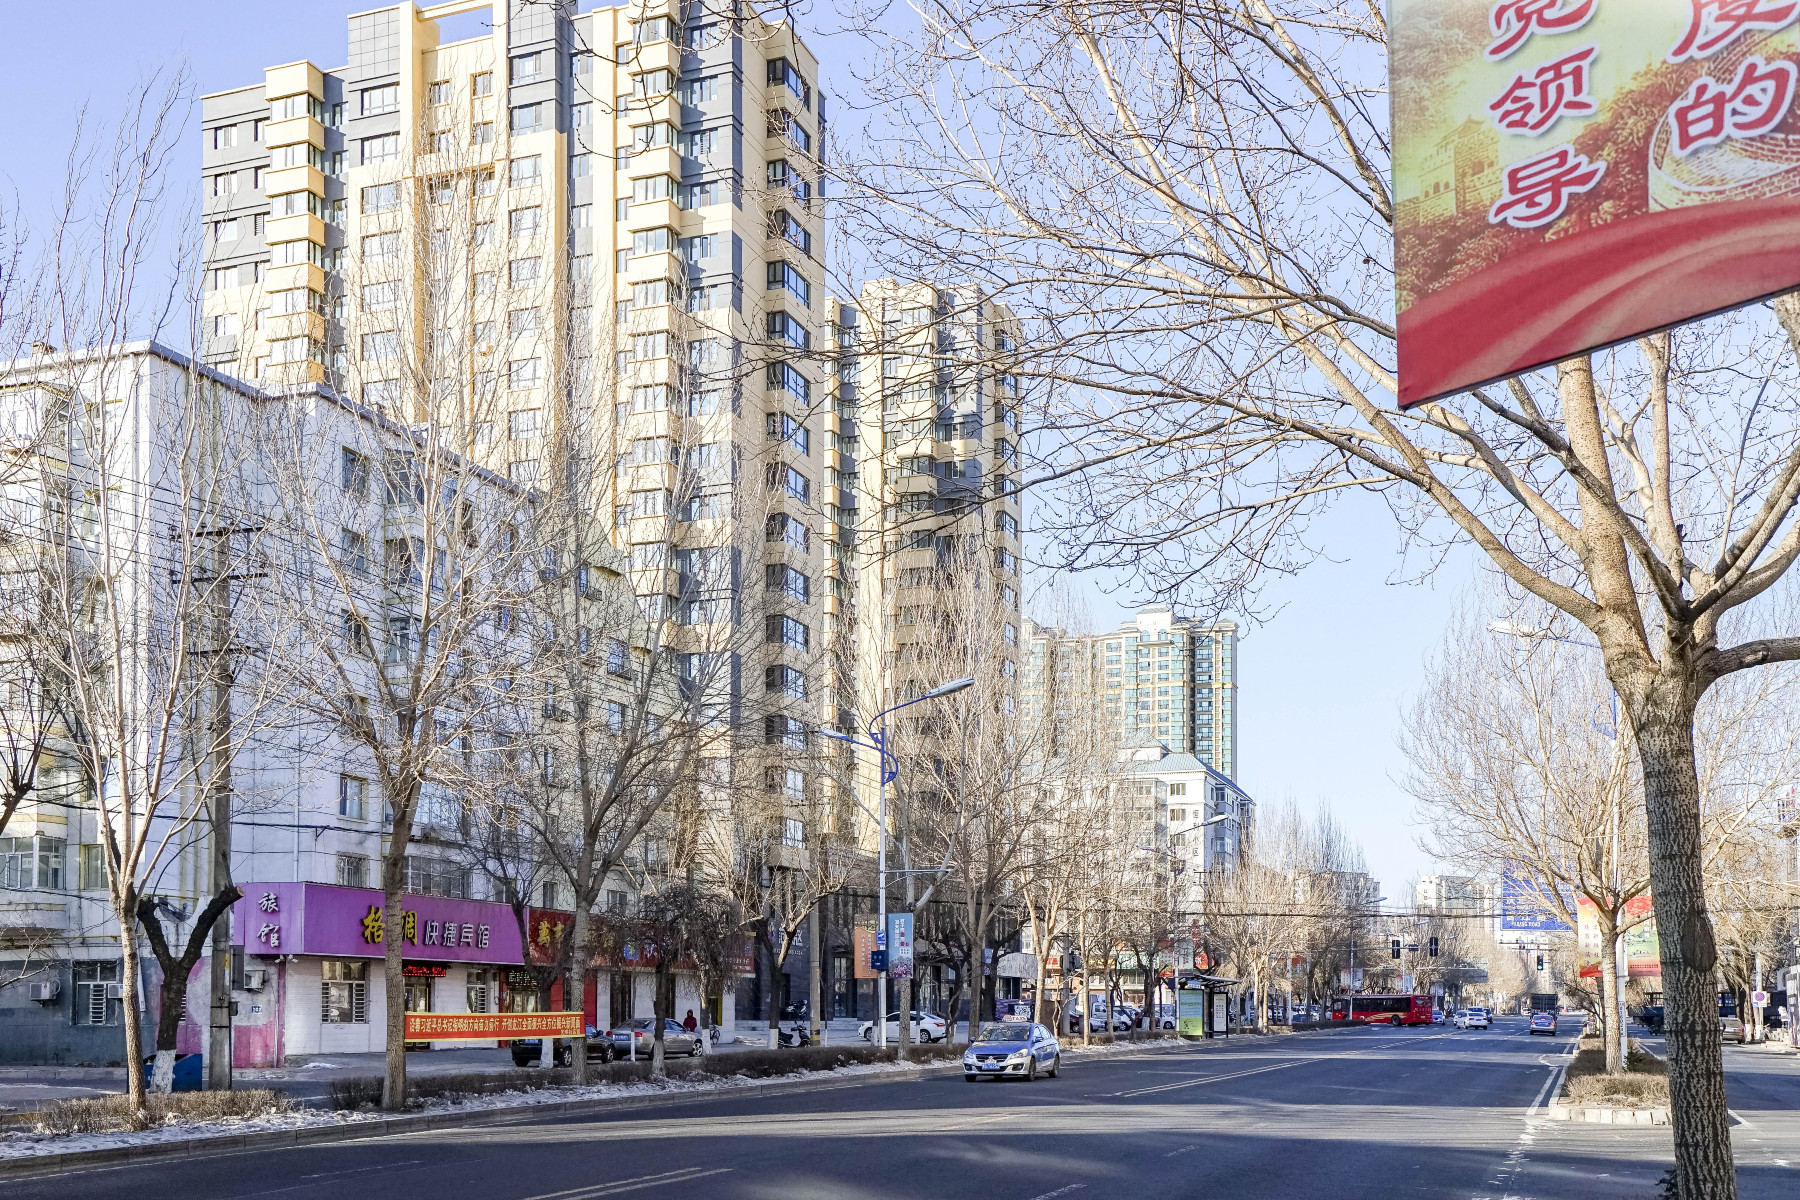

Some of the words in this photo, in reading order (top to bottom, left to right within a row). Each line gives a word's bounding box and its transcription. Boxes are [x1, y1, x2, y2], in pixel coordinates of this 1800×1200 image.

[256, 891, 281, 949] 旅馆
[424, 919, 491, 948] 快捷宾馆
